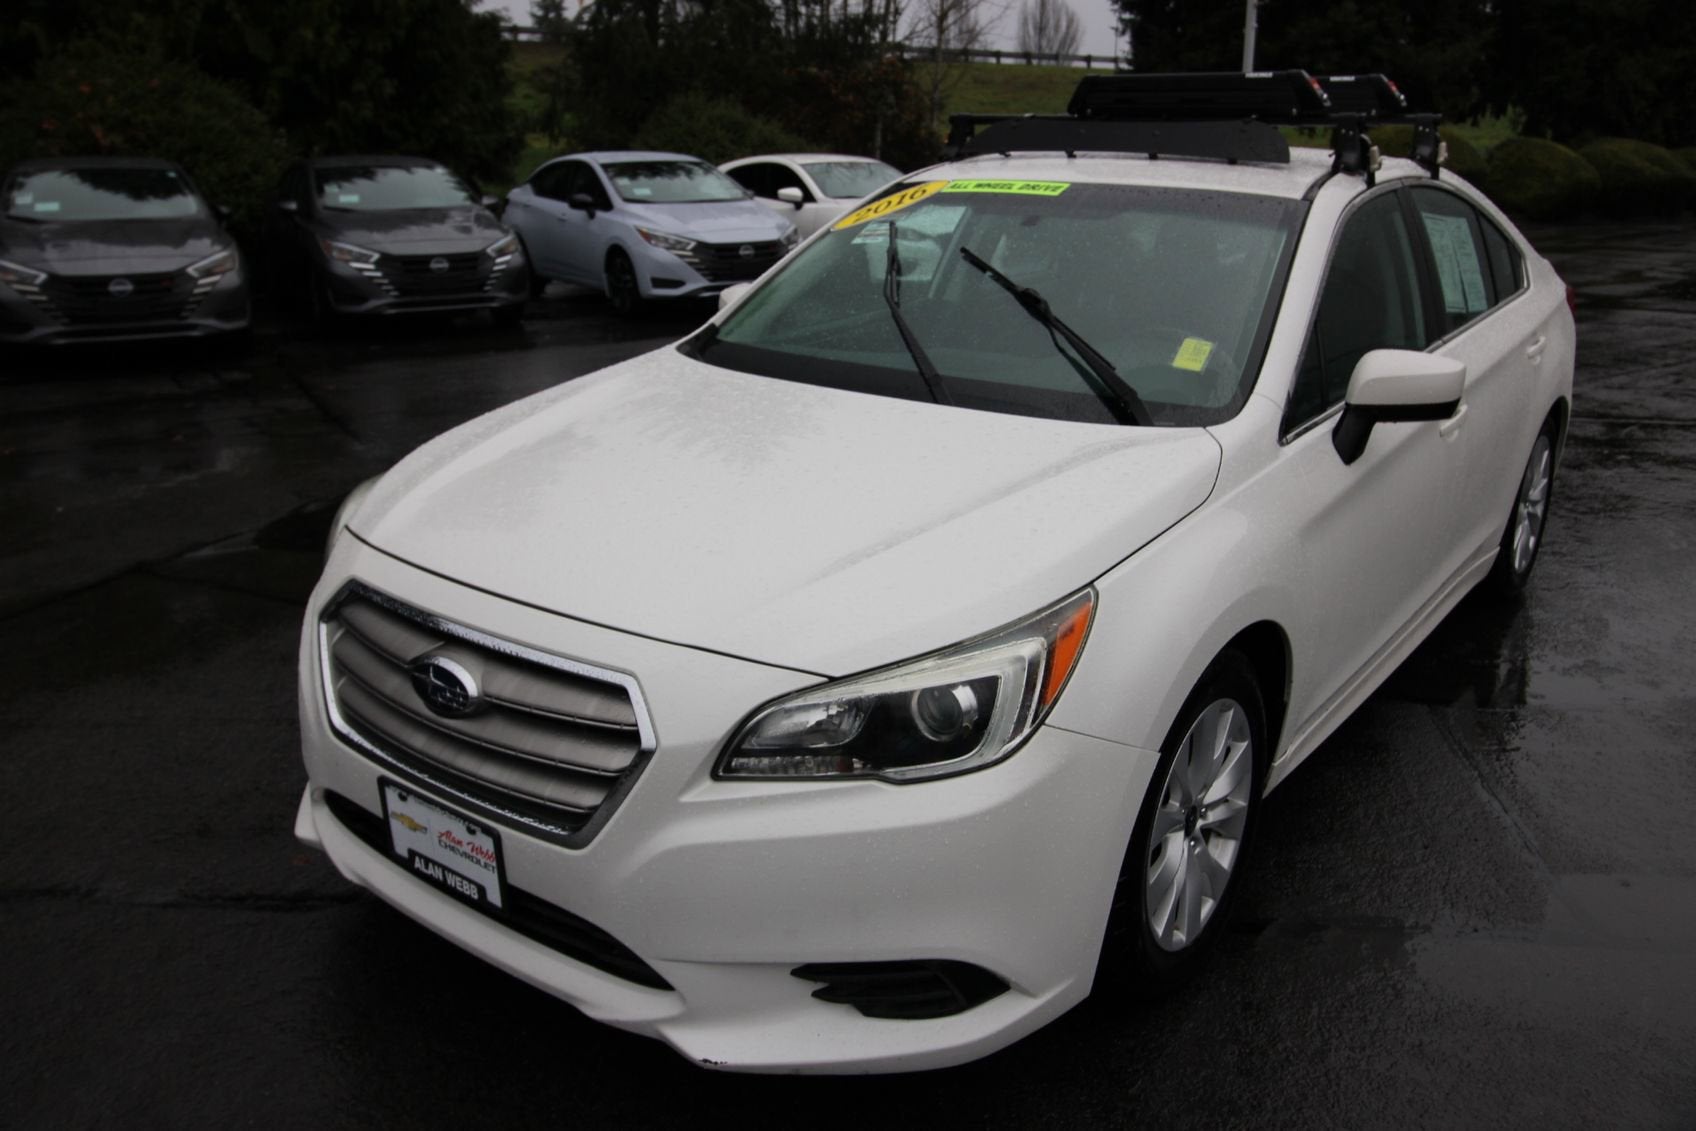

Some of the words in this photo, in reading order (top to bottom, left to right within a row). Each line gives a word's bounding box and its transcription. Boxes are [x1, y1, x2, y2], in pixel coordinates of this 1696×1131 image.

[950, 182, 971, 190] ALL
[973, 182, 1015, 191] WHEEL
[1018, 183, 1062, 193] DRIVE
[852, 187, 927, 223] 2016
[437, 830, 464, 848] Alan
[467, 841, 497, 863] Webb
[438, 839, 496, 873] CHEVROLET
[414, 855, 444, 882] ALAN
[445, 870, 479, 900] WEBB
